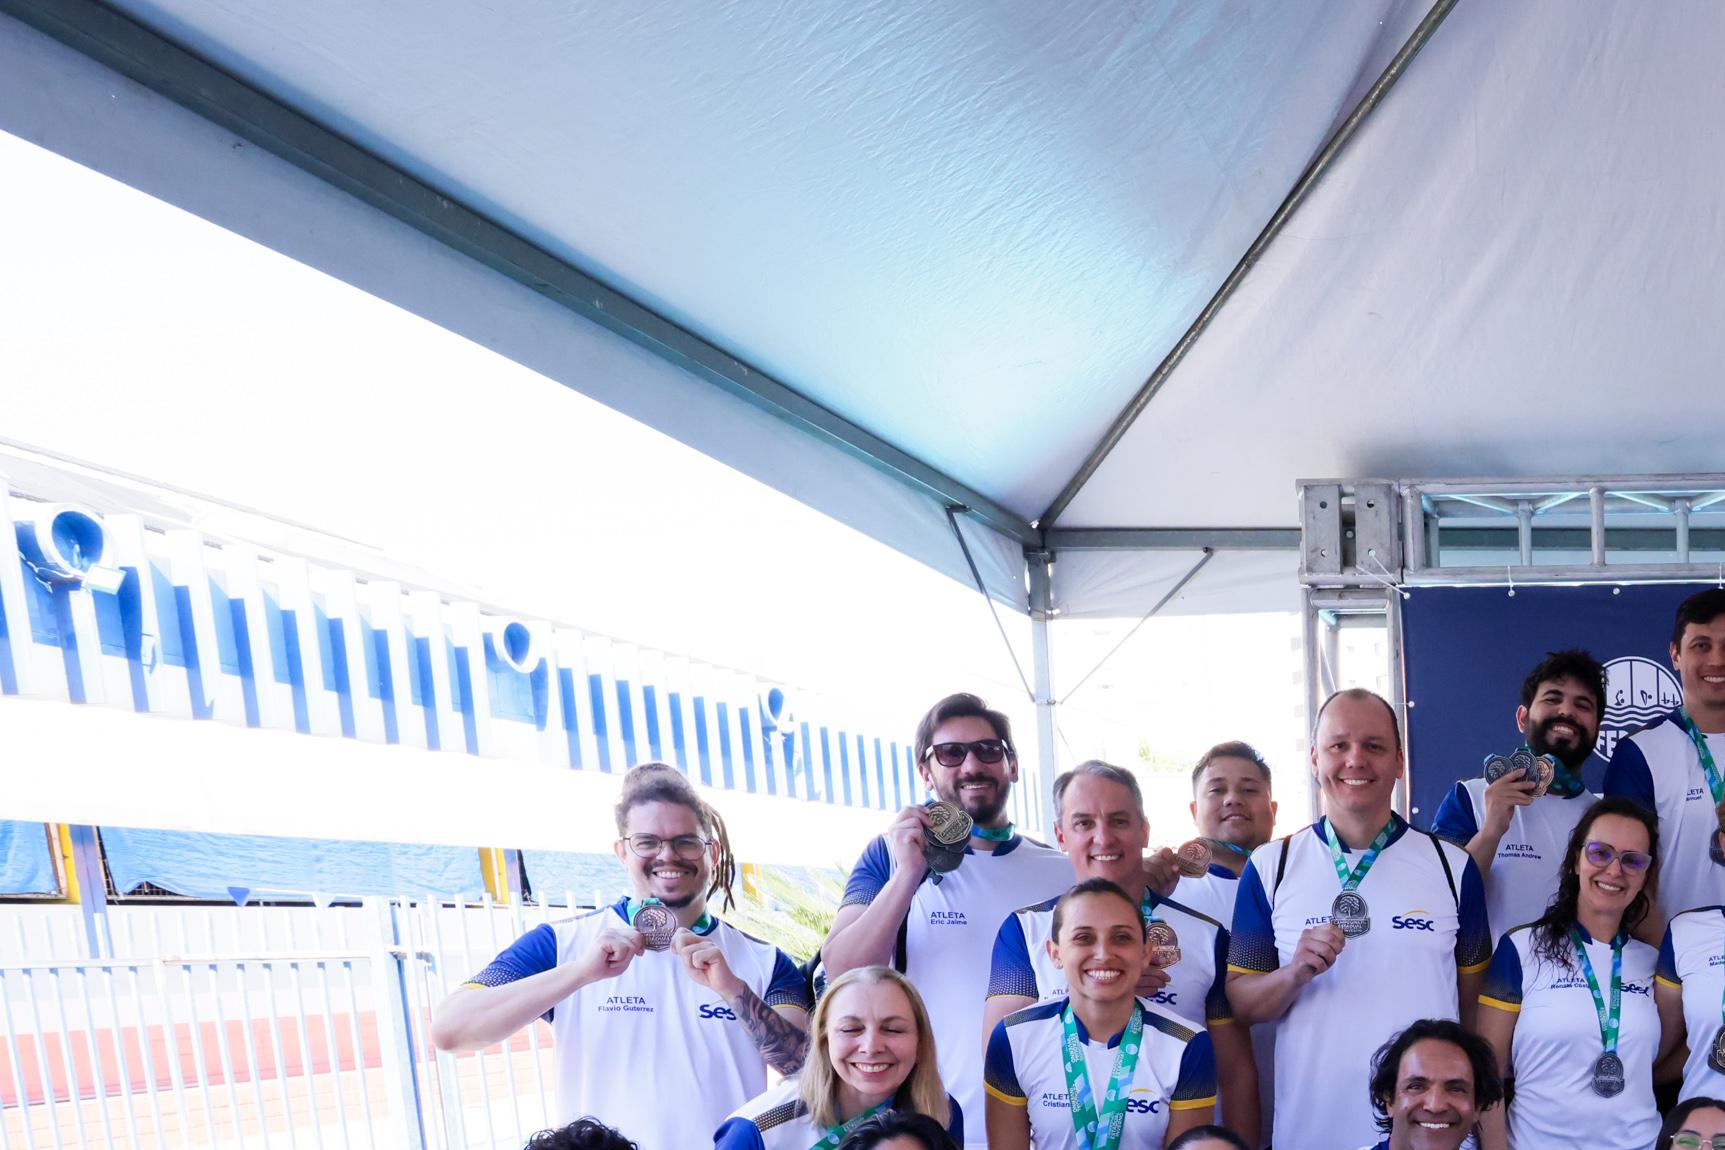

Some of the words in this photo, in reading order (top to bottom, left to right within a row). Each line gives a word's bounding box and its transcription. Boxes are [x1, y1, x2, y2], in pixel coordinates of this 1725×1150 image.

[1506, 844, 1534, 852] ATLETA
[1305, 916, 1333, 926] ATLET
[1392, 916, 1434, 932] Sesc
[606, 996, 646, 1004] ATLETA
[700, 1004, 736, 1020] Ses
[1042, 1100, 1070, 1108] Cristian
[1126, 1098, 1160, 1114] esc
